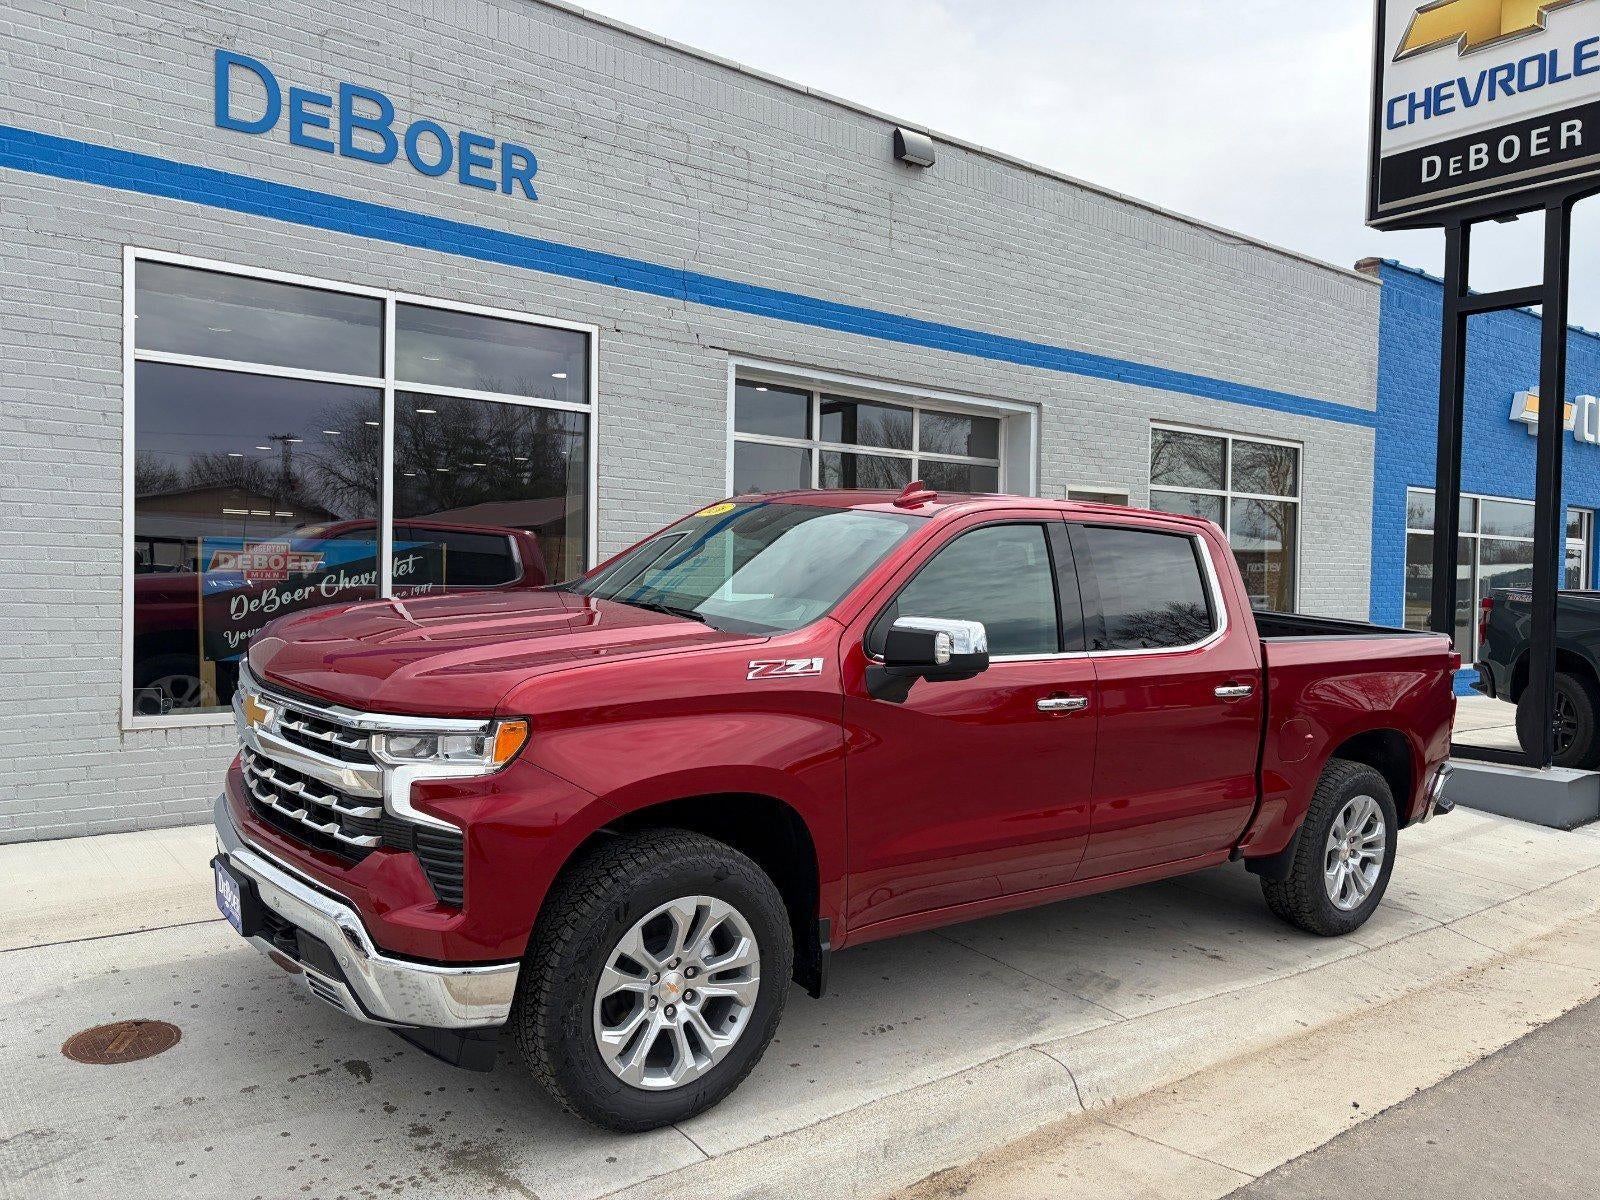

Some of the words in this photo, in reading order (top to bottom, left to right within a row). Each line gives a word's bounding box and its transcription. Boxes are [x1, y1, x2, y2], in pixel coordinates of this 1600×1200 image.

[218, 553, 316, 571] DEBOER
[230, 587, 315, 620] DeBoer
[321, 554, 424, 598] Chevrlet
